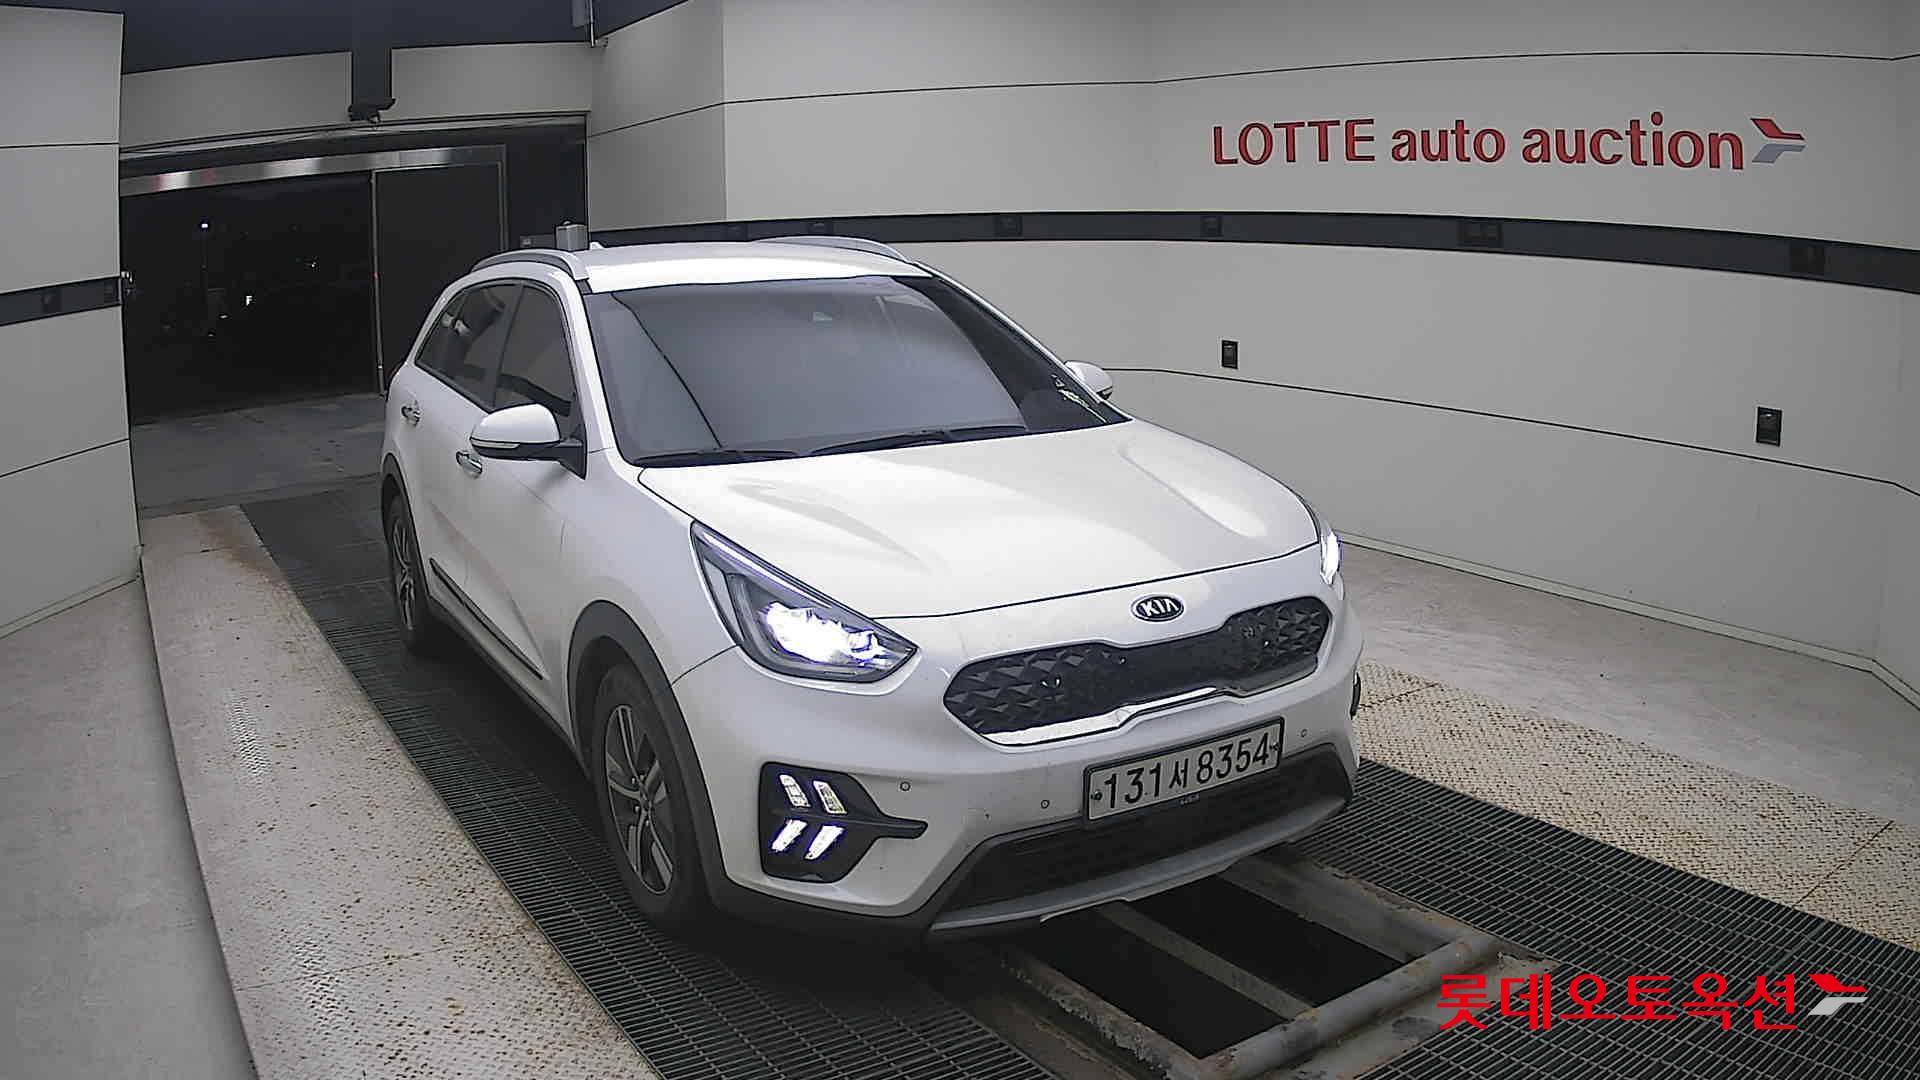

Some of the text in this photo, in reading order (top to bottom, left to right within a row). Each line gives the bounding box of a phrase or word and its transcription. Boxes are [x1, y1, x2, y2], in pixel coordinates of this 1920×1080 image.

[1213, 111, 1744, 170] LOTTE auto auction
[1139, 598, 1180, 617] KIA
